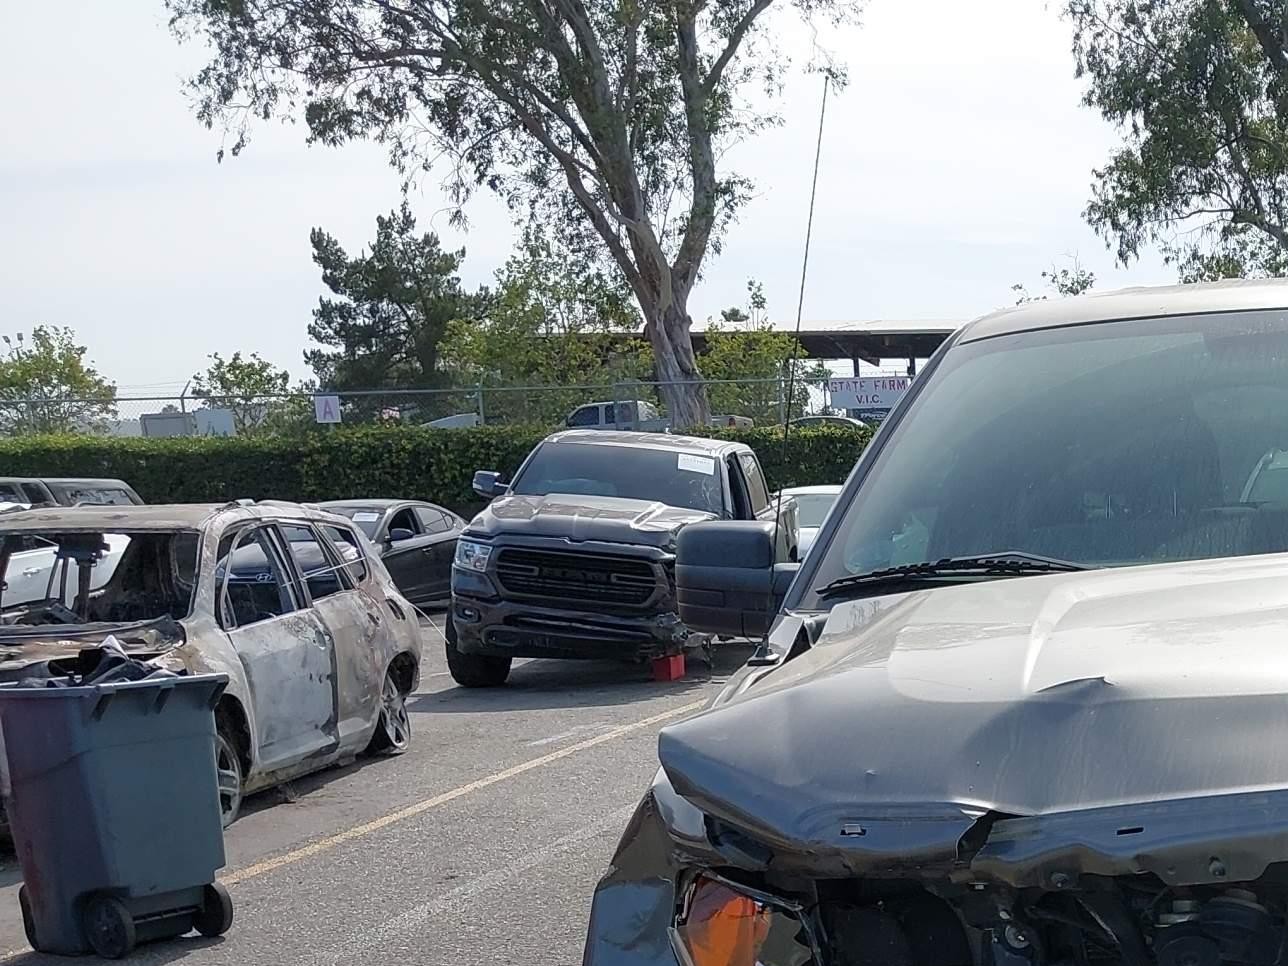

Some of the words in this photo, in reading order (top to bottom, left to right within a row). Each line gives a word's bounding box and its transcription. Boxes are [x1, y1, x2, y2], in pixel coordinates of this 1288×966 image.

[831, 380, 865, 393] STATE
[874, 379, 906, 391] FARM
[856, 394, 882, 405] V.I.C.
[323, 399, 335, 420] A
